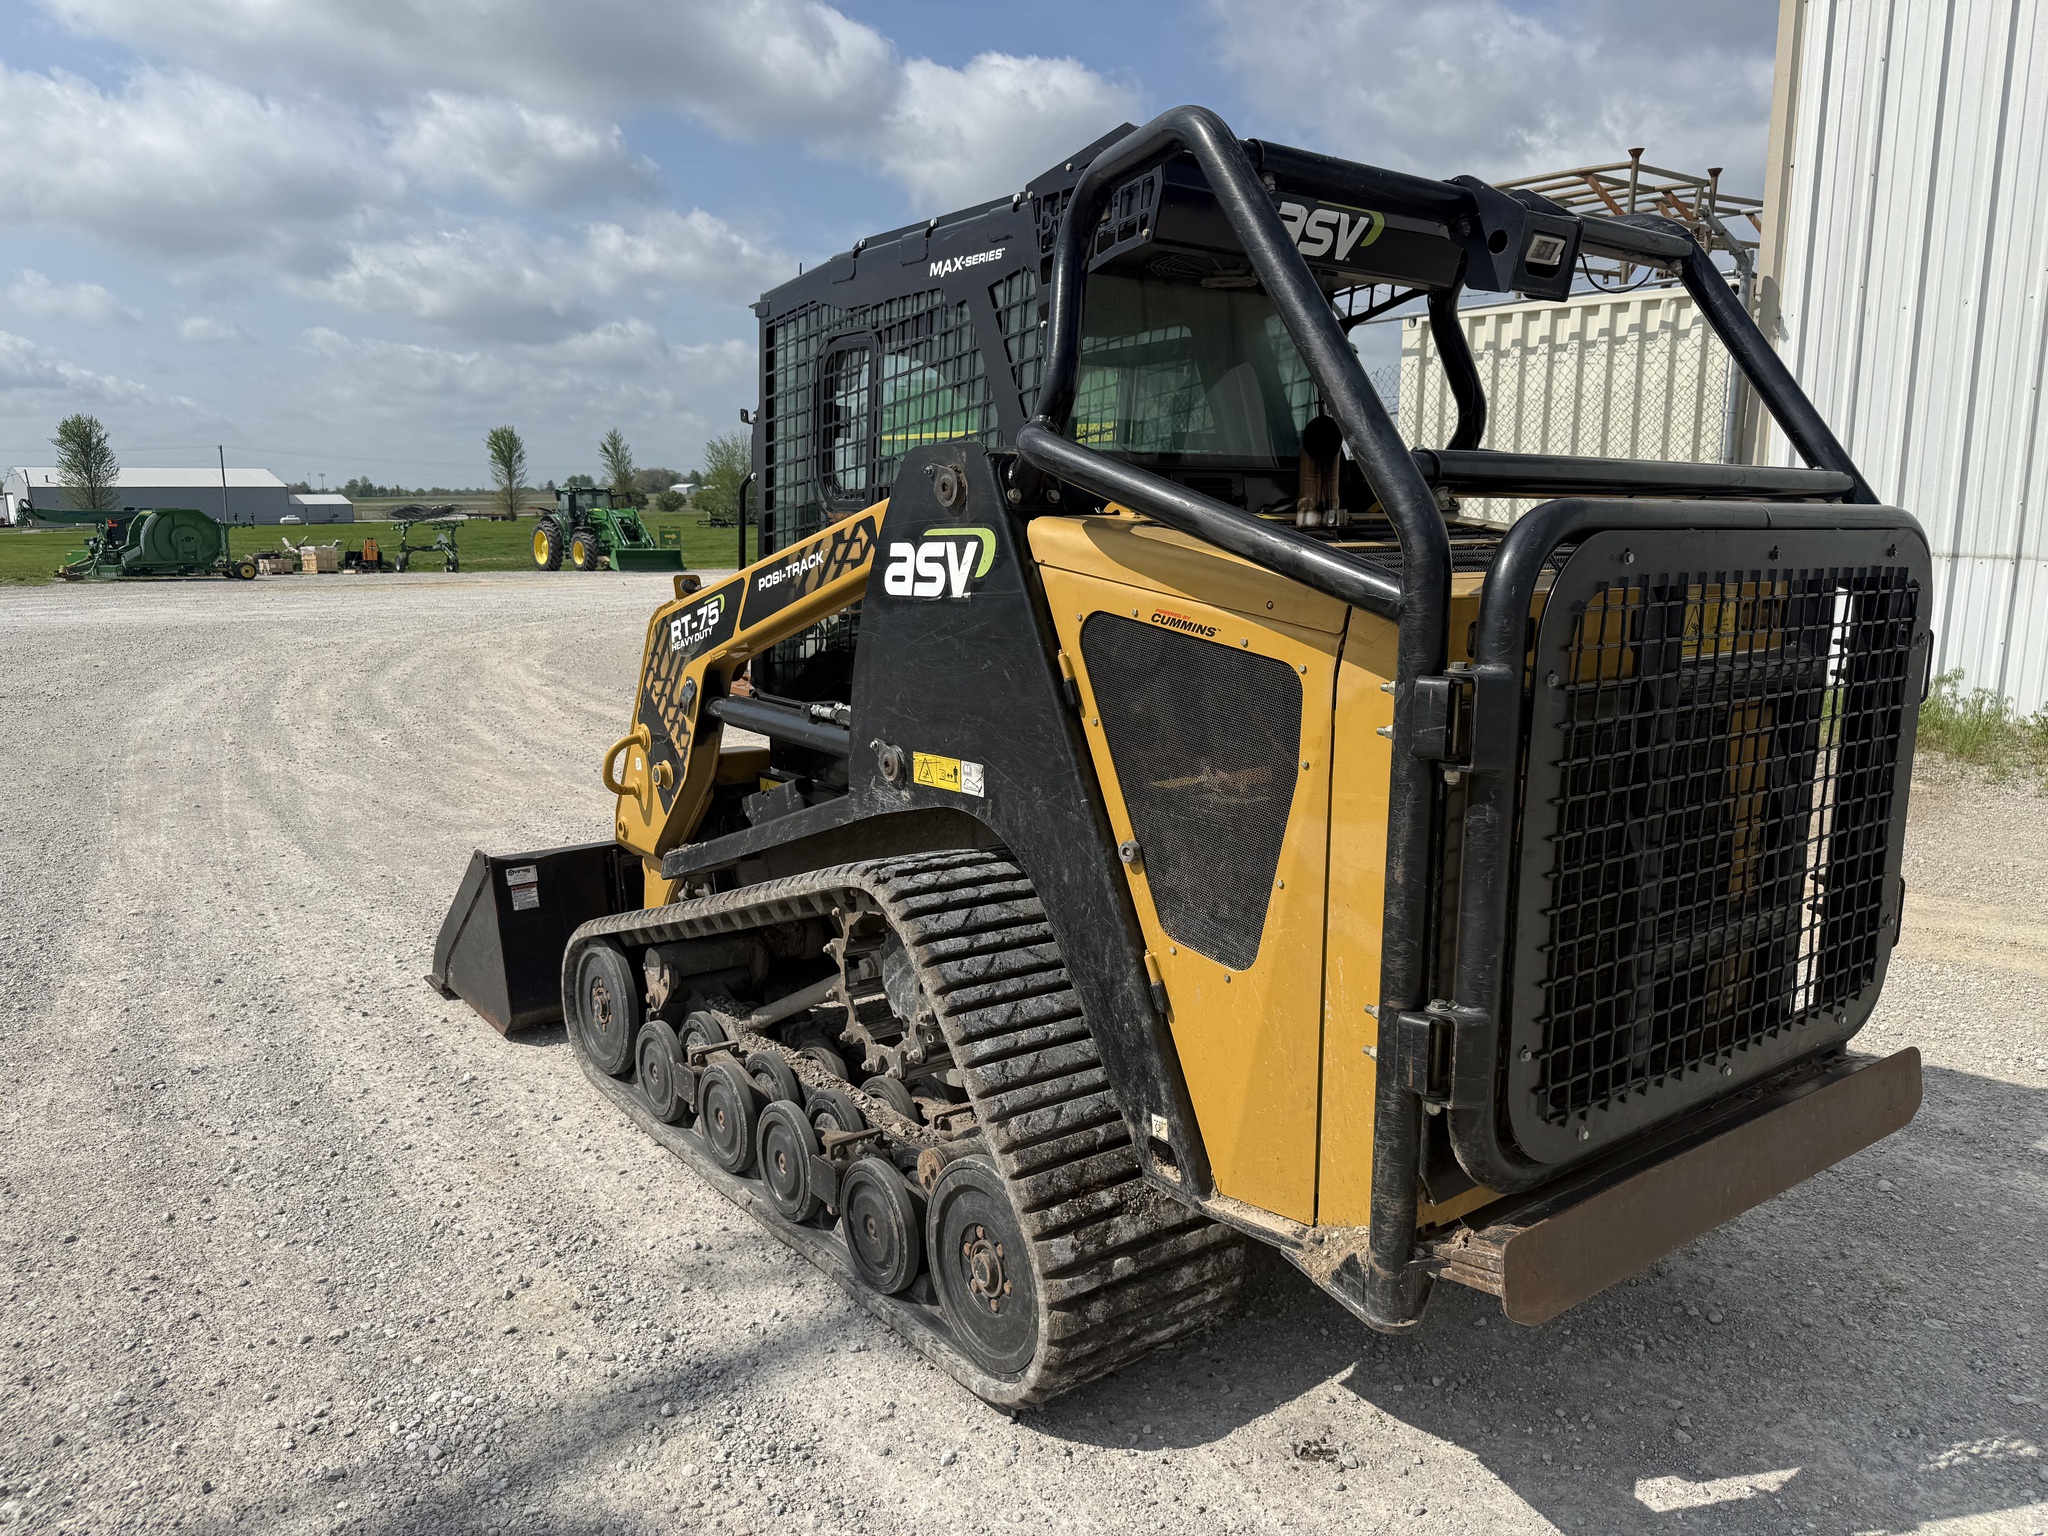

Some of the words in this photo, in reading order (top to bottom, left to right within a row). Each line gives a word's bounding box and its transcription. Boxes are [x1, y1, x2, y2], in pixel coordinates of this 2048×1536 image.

[929, 247, 1003, 278] MAX-SERIES
[758, 550, 824, 592] POSI-TRACK
[670, 600, 719, 644] RT-75
[1150, 612, 1217, 637] CUMMINS
[1156, 608, 1182, 619] POWERED
[671, 634, 694, 652] HEAVY
[694, 625, 713, 643] DUTY
